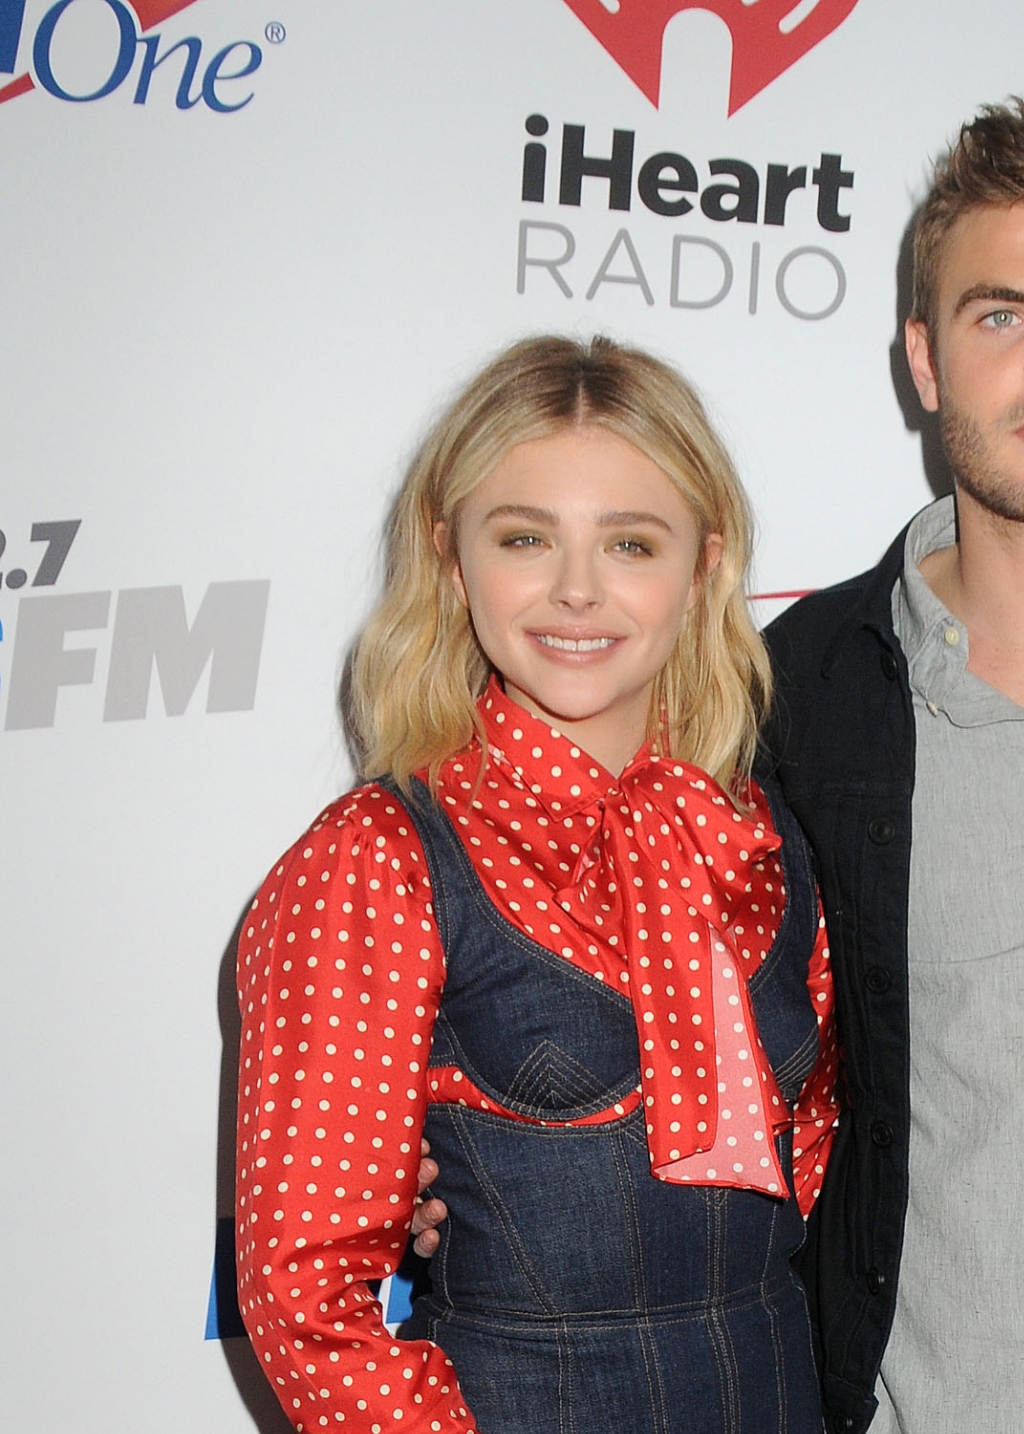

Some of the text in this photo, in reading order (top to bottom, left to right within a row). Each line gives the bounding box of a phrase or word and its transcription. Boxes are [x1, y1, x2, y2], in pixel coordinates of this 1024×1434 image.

[521, 113, 855, 233] iHeart
[516, 219, 847, 321] RADIO
[0, 578, 271, 731] FM
